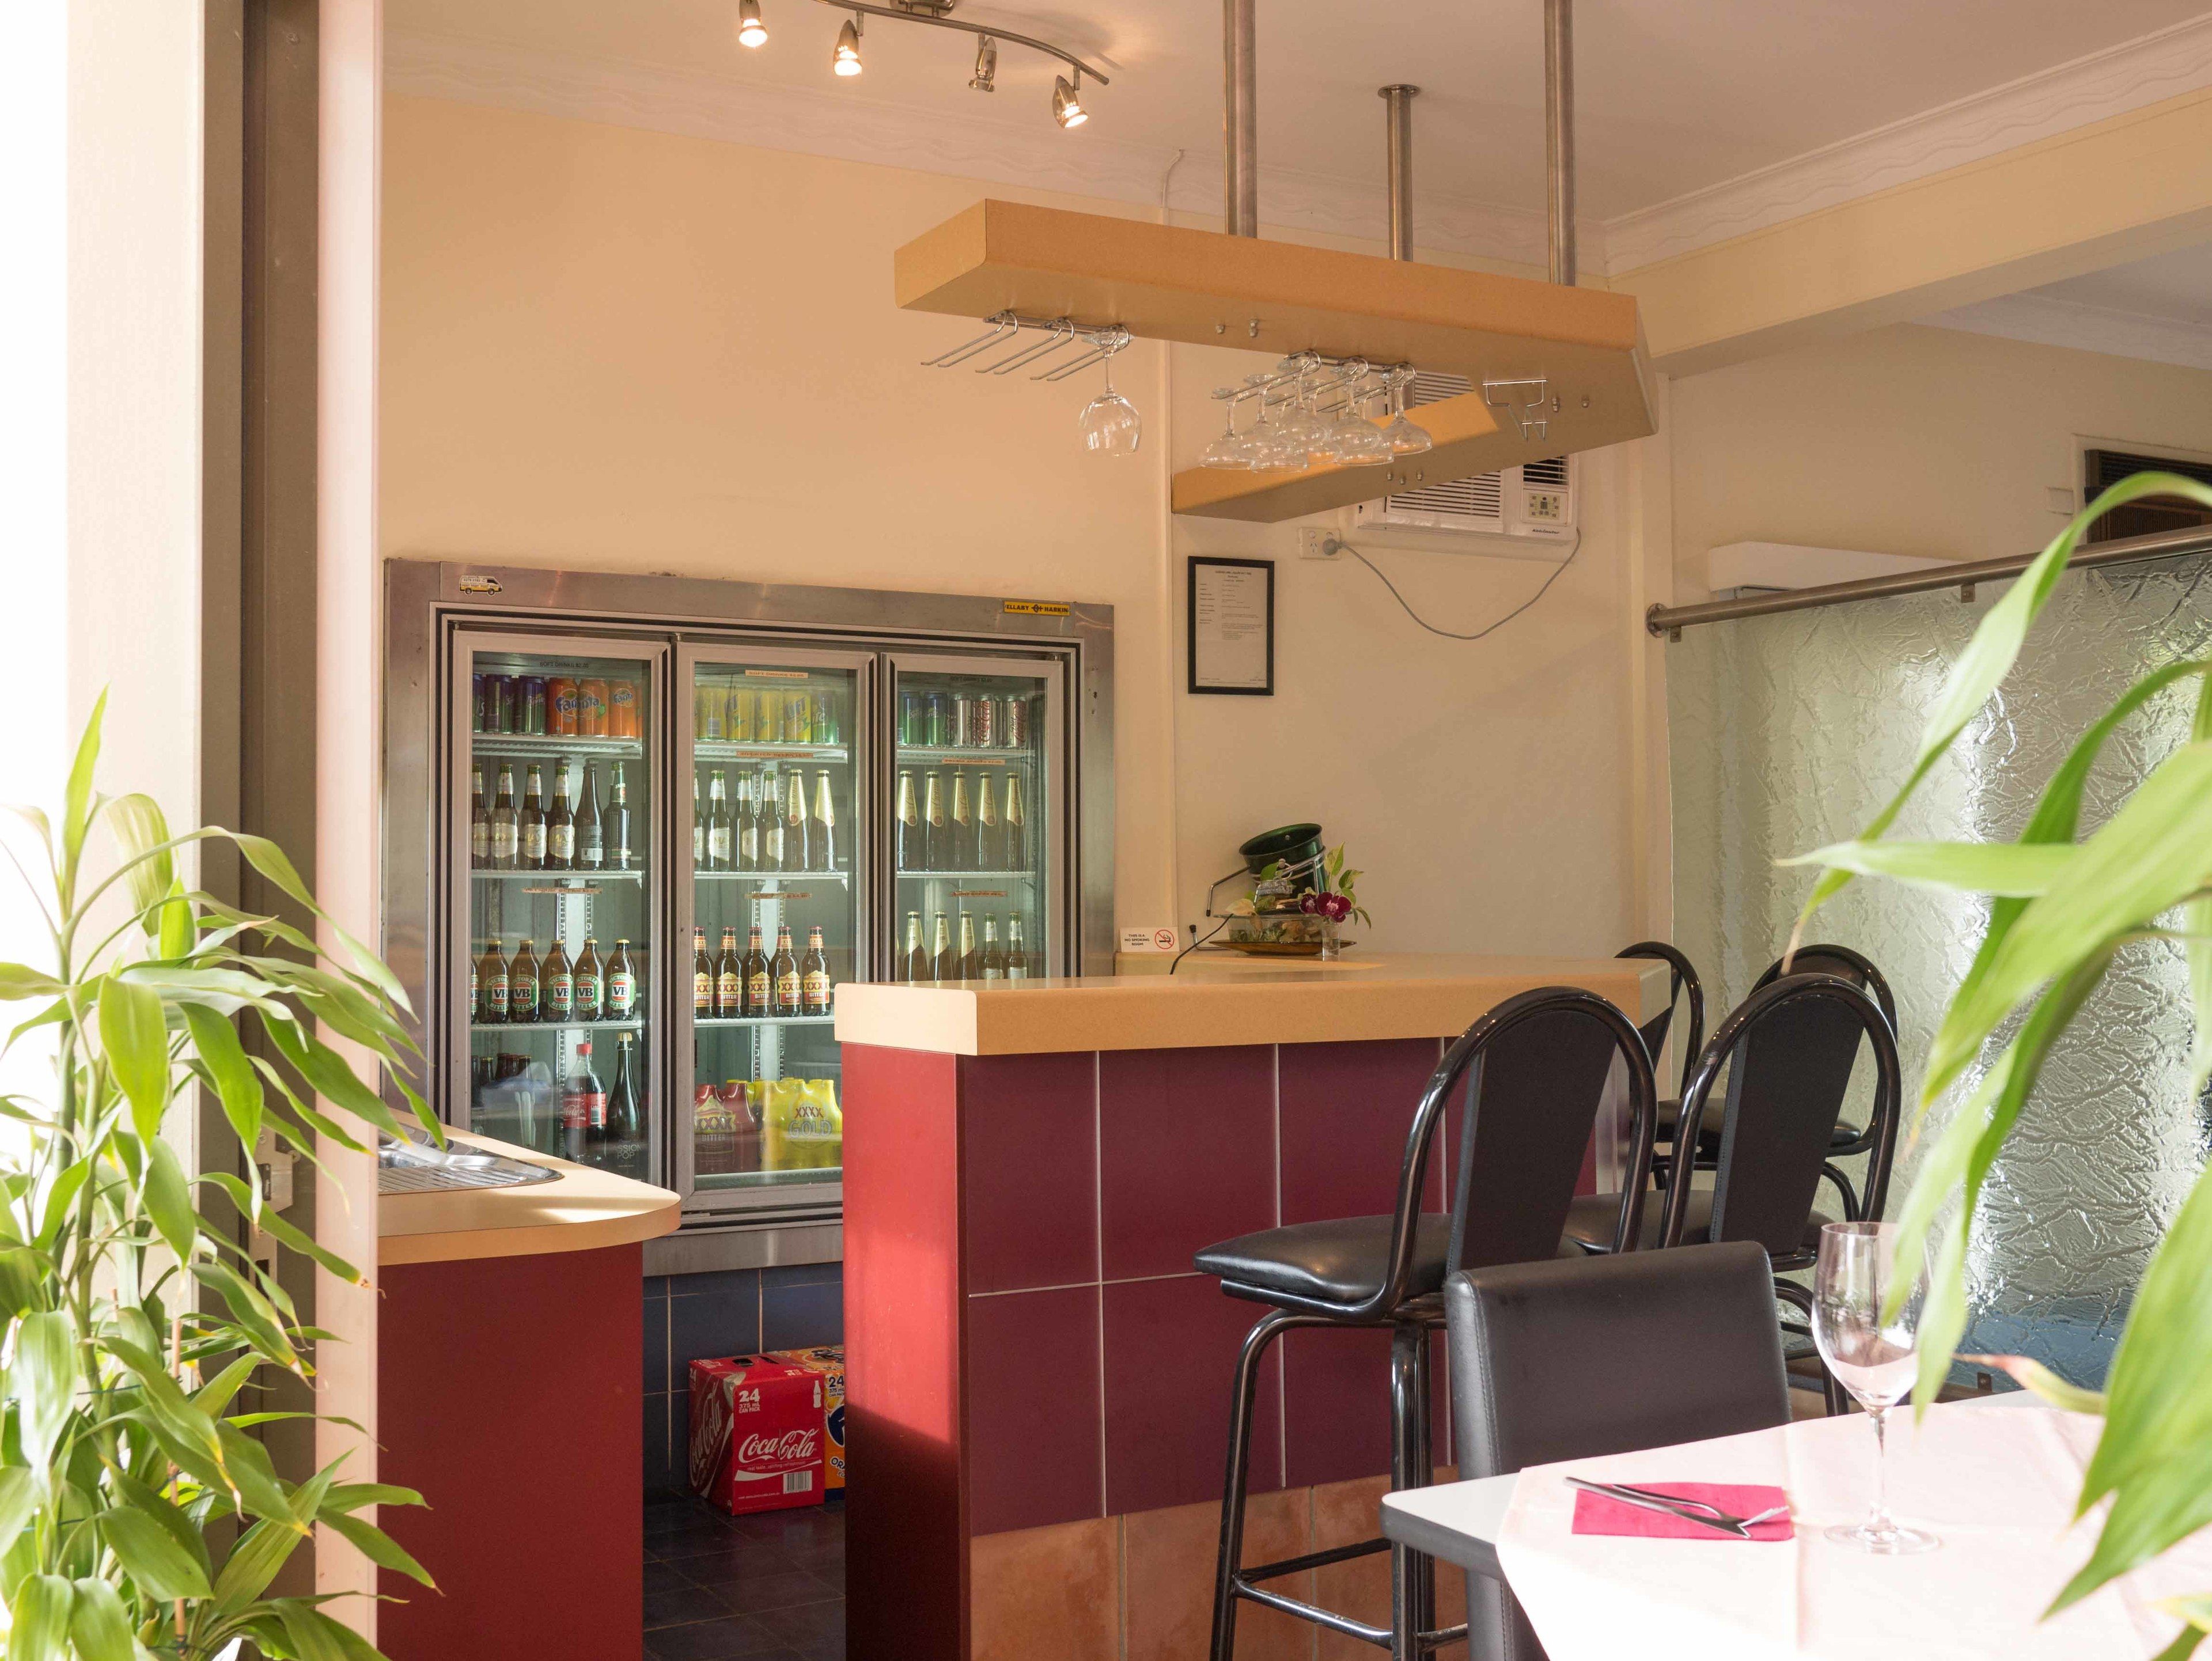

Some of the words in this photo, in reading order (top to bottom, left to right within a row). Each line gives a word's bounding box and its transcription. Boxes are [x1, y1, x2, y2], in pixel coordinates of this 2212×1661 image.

[514, 987, 531, 998] VB
[578, 987, 593, 997] VB
[612, 986, 627, 996] VB
[795, 1106, 824, 1118] XXXX
[788, 1119, 832, 1138] GOLD
[828, 1375, 844, 1387] 24
[738, 1388, 760, 1402] 24
